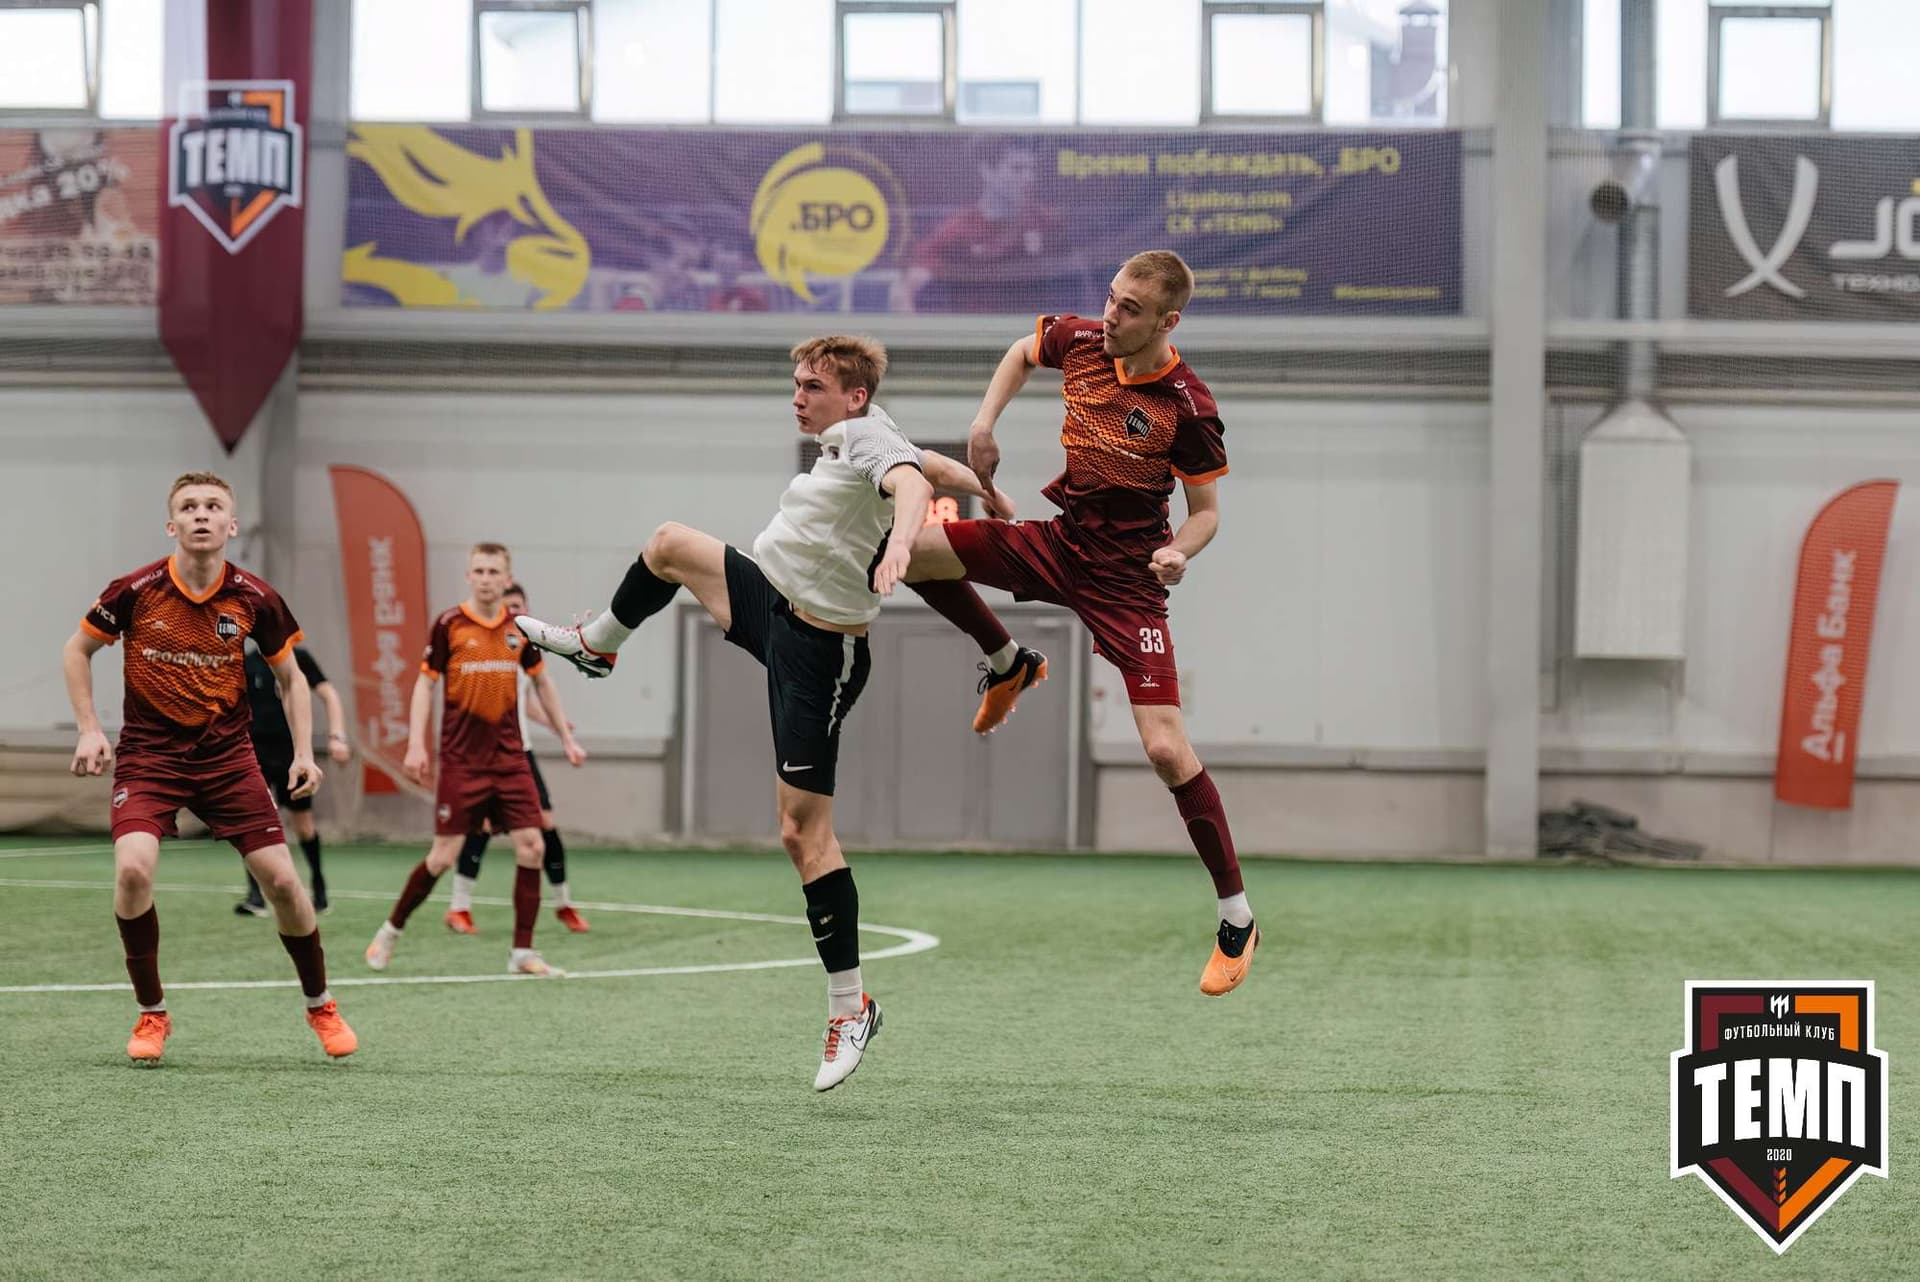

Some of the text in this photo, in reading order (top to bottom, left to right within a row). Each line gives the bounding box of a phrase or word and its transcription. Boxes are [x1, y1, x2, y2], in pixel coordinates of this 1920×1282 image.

[182, 127, 287, 188] ТЕМП
[1057, 149, 1150, 179] Время
[1127, 414, 1149, 437] ТЕМП
[1139, 627, 1165, 654] 33
[1801, 549, 1857, 762] Альфа Банк
